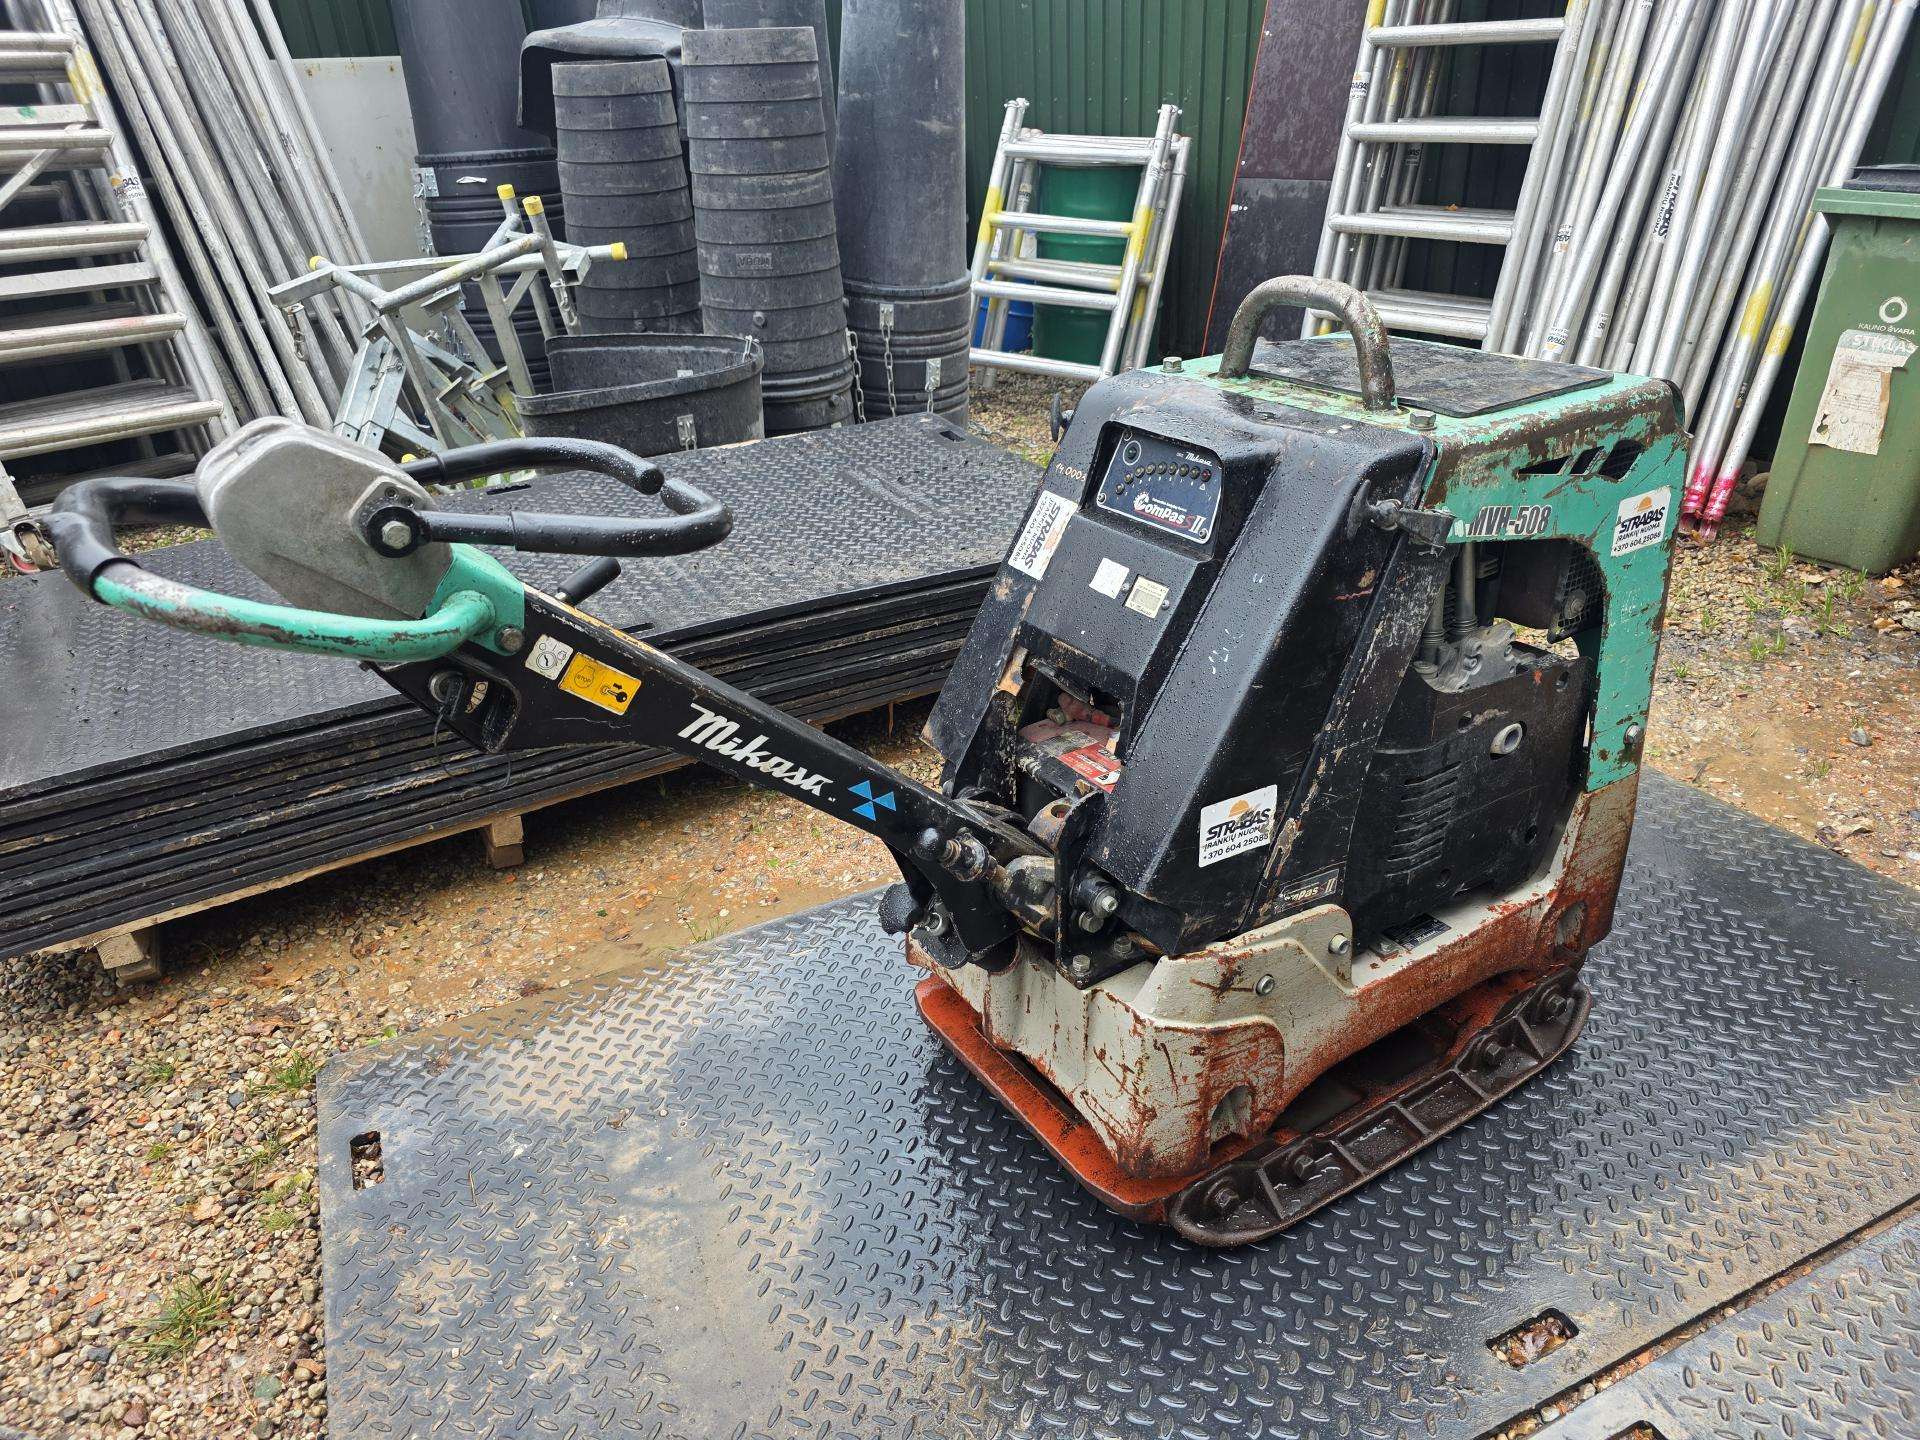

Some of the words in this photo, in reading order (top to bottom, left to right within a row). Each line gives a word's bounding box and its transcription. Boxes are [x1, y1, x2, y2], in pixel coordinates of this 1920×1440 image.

[1857, 322, 1887, 333] KAUNO
[1887, 324, 1915, 335] ŠVARA
[1185, 451, 1213, 467] Mikasa
[1465, 504, 1553, 538] MVH-508
[1618, 506, 1666, 534] STRABAS
[1024, 502, 1061, 569] STRABAS
[1615, 529, 1640, 545] ĮRANKIŲ
[1640, 522, 1661, 534] NUOMA
[1630, 537, 1642, 548] 604
[1020, 532, 1039, 561] NUOMA
[576, 673, 592, 683] STOP
[676, 702, 834, 797] Mikasa
[1205, 808, 1272, 841] STRABAS
[1225, 842, 1242, 853] 604
